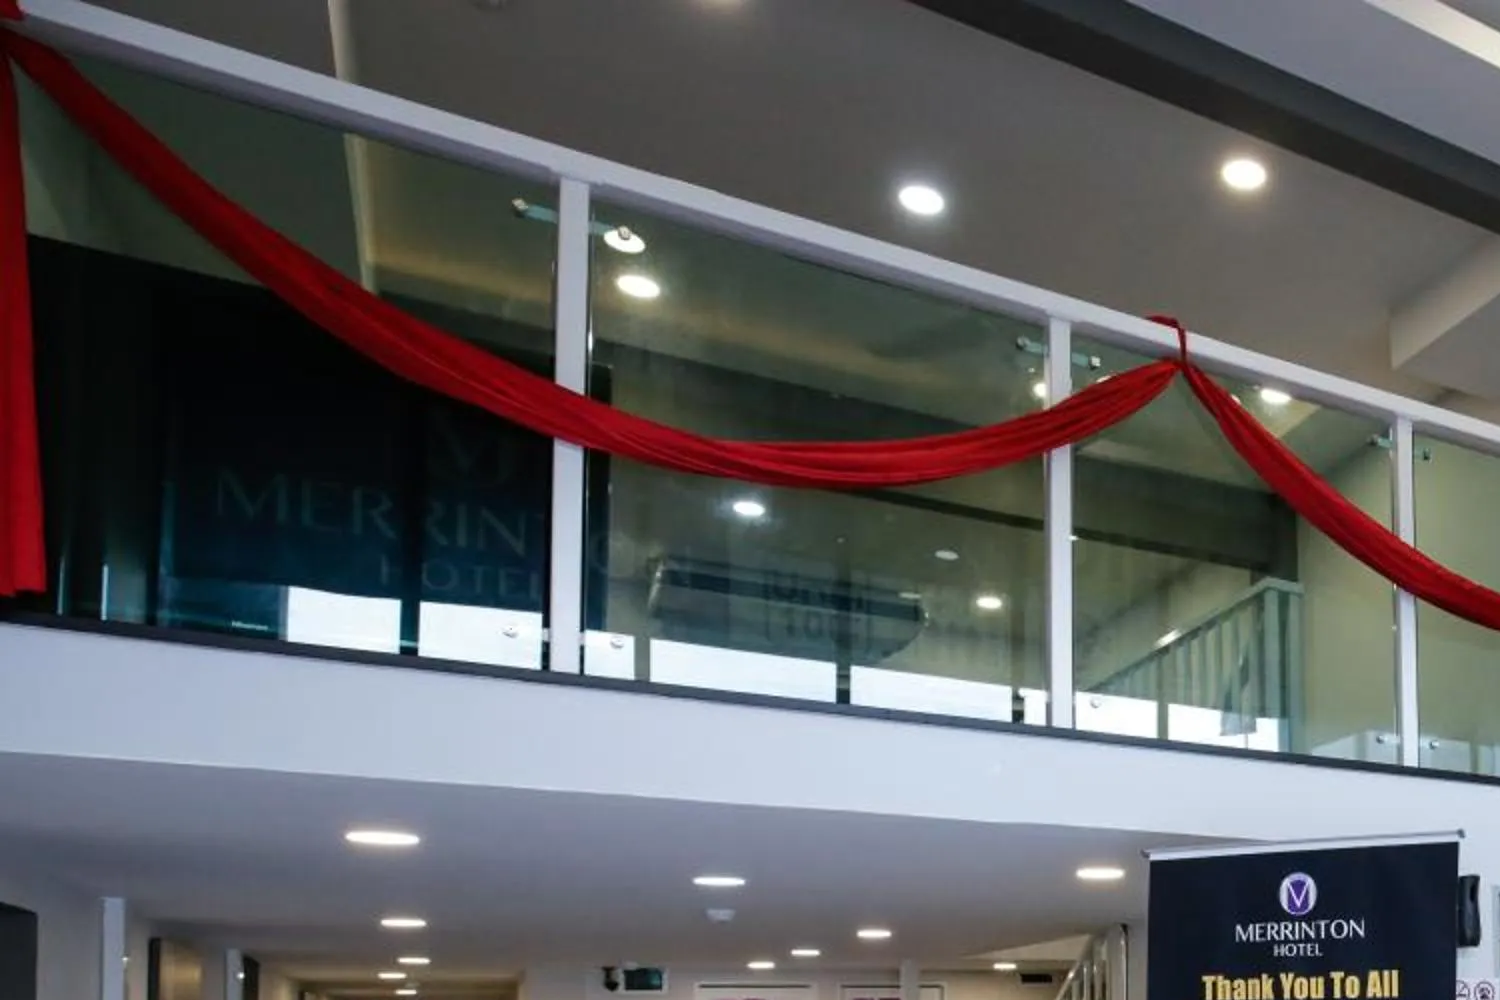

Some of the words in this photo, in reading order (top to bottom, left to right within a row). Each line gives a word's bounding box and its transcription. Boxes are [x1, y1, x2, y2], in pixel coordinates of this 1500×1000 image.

[215, 468, 546, 558] MERRIN
[1235, 917, 1365, 943] MERRINTON
[1273, 944, 1323, 957] HOTEL
[1202, 973, 1274, 1000] Thank
[1280, 972, 1324, 1000] You
[1329, 971, 1359, 999] To
[1367, 970, 1399, 998] All
